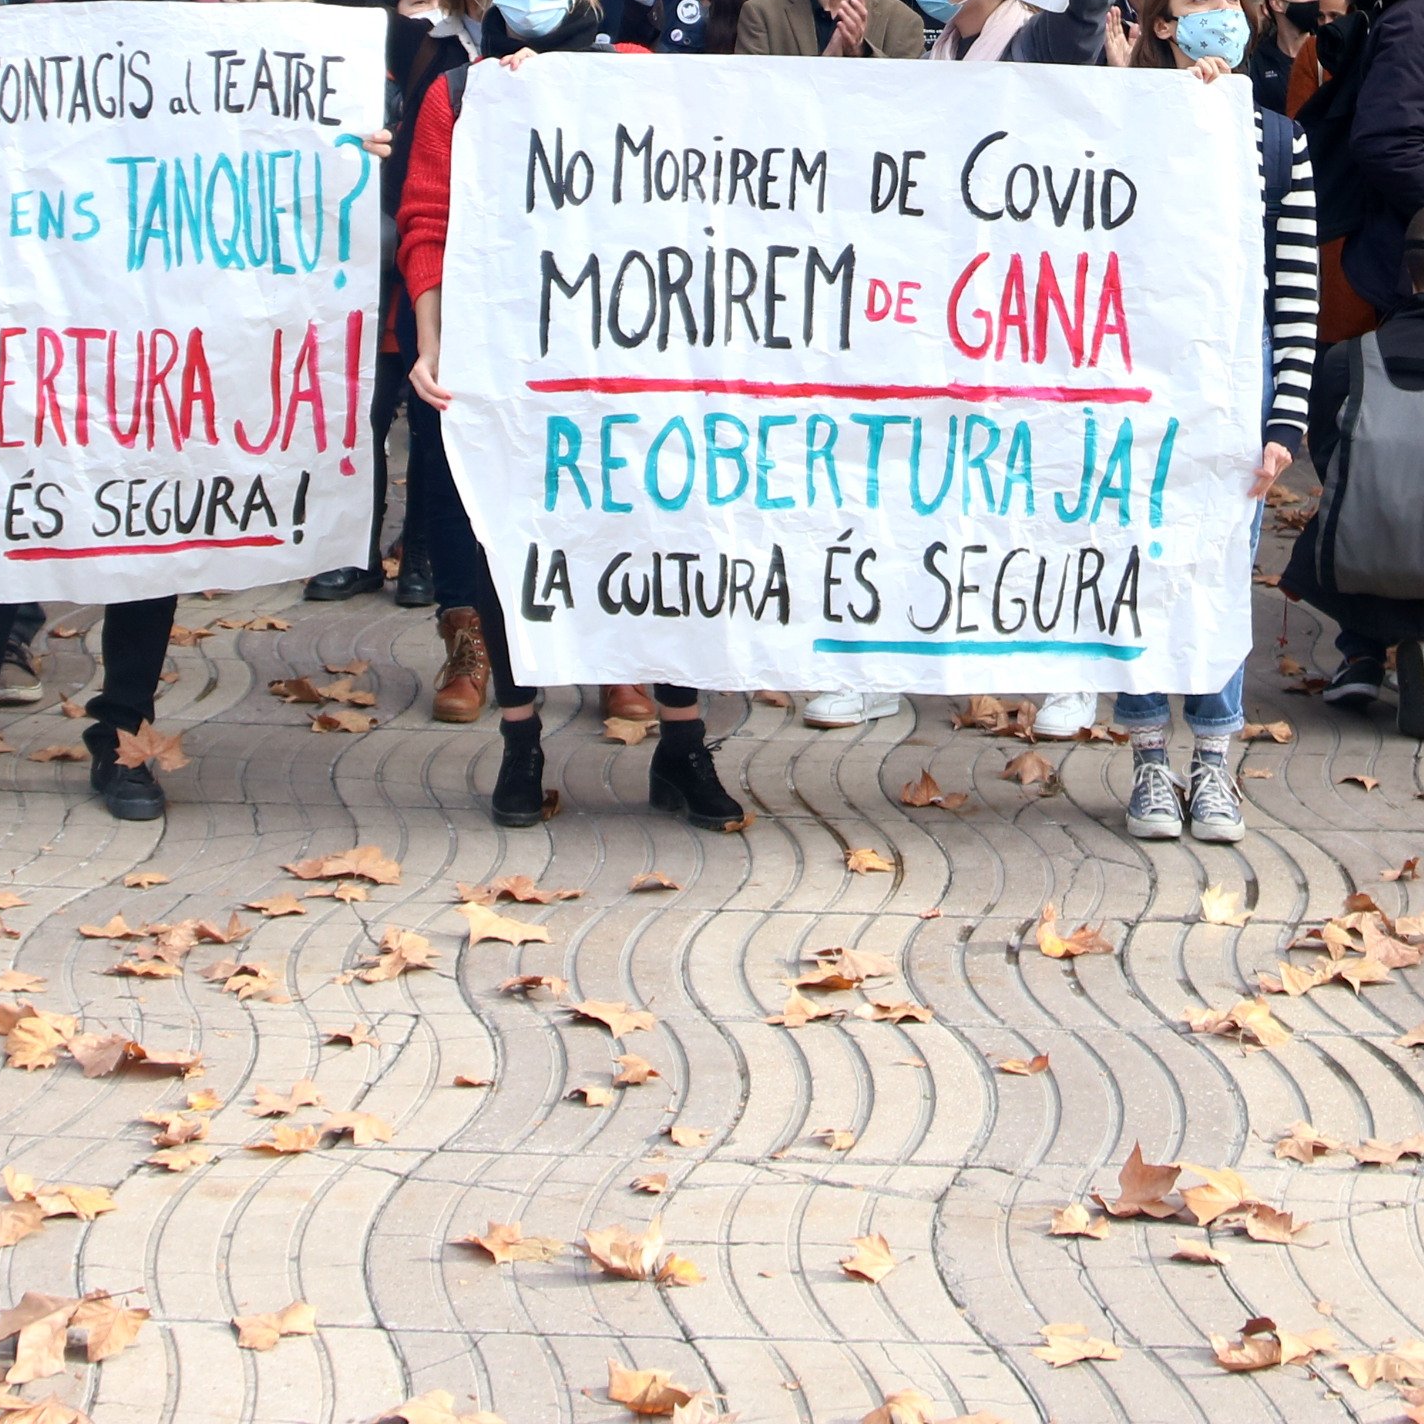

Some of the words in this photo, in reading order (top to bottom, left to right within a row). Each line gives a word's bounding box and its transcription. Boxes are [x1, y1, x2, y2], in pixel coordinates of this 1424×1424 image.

[207, 47, 345, 126] TEATRE
[10, 190, 100, 241] ENS
[108, 133, 370, 289] TANQUEU?
[870, 149, 926, 216] DE
[864, 279, 917, 324] DE
[947, 251, 1132, 374] GANA
[234, 311, 363, 477] JA!
[5, 469, 63, 541] ÉS
[91, 471, 310, 544] SEGURA!
[545, 409, 1035, 517] REOBERTURA
[1056, 405, 1179, 559] JA!
[520, 541, 573, 624] LA
[598, 542, 789, 626] CULTURA
[822, 526, 879, 624] ÉS
[907, 542, 1142, 638] SEGURA
